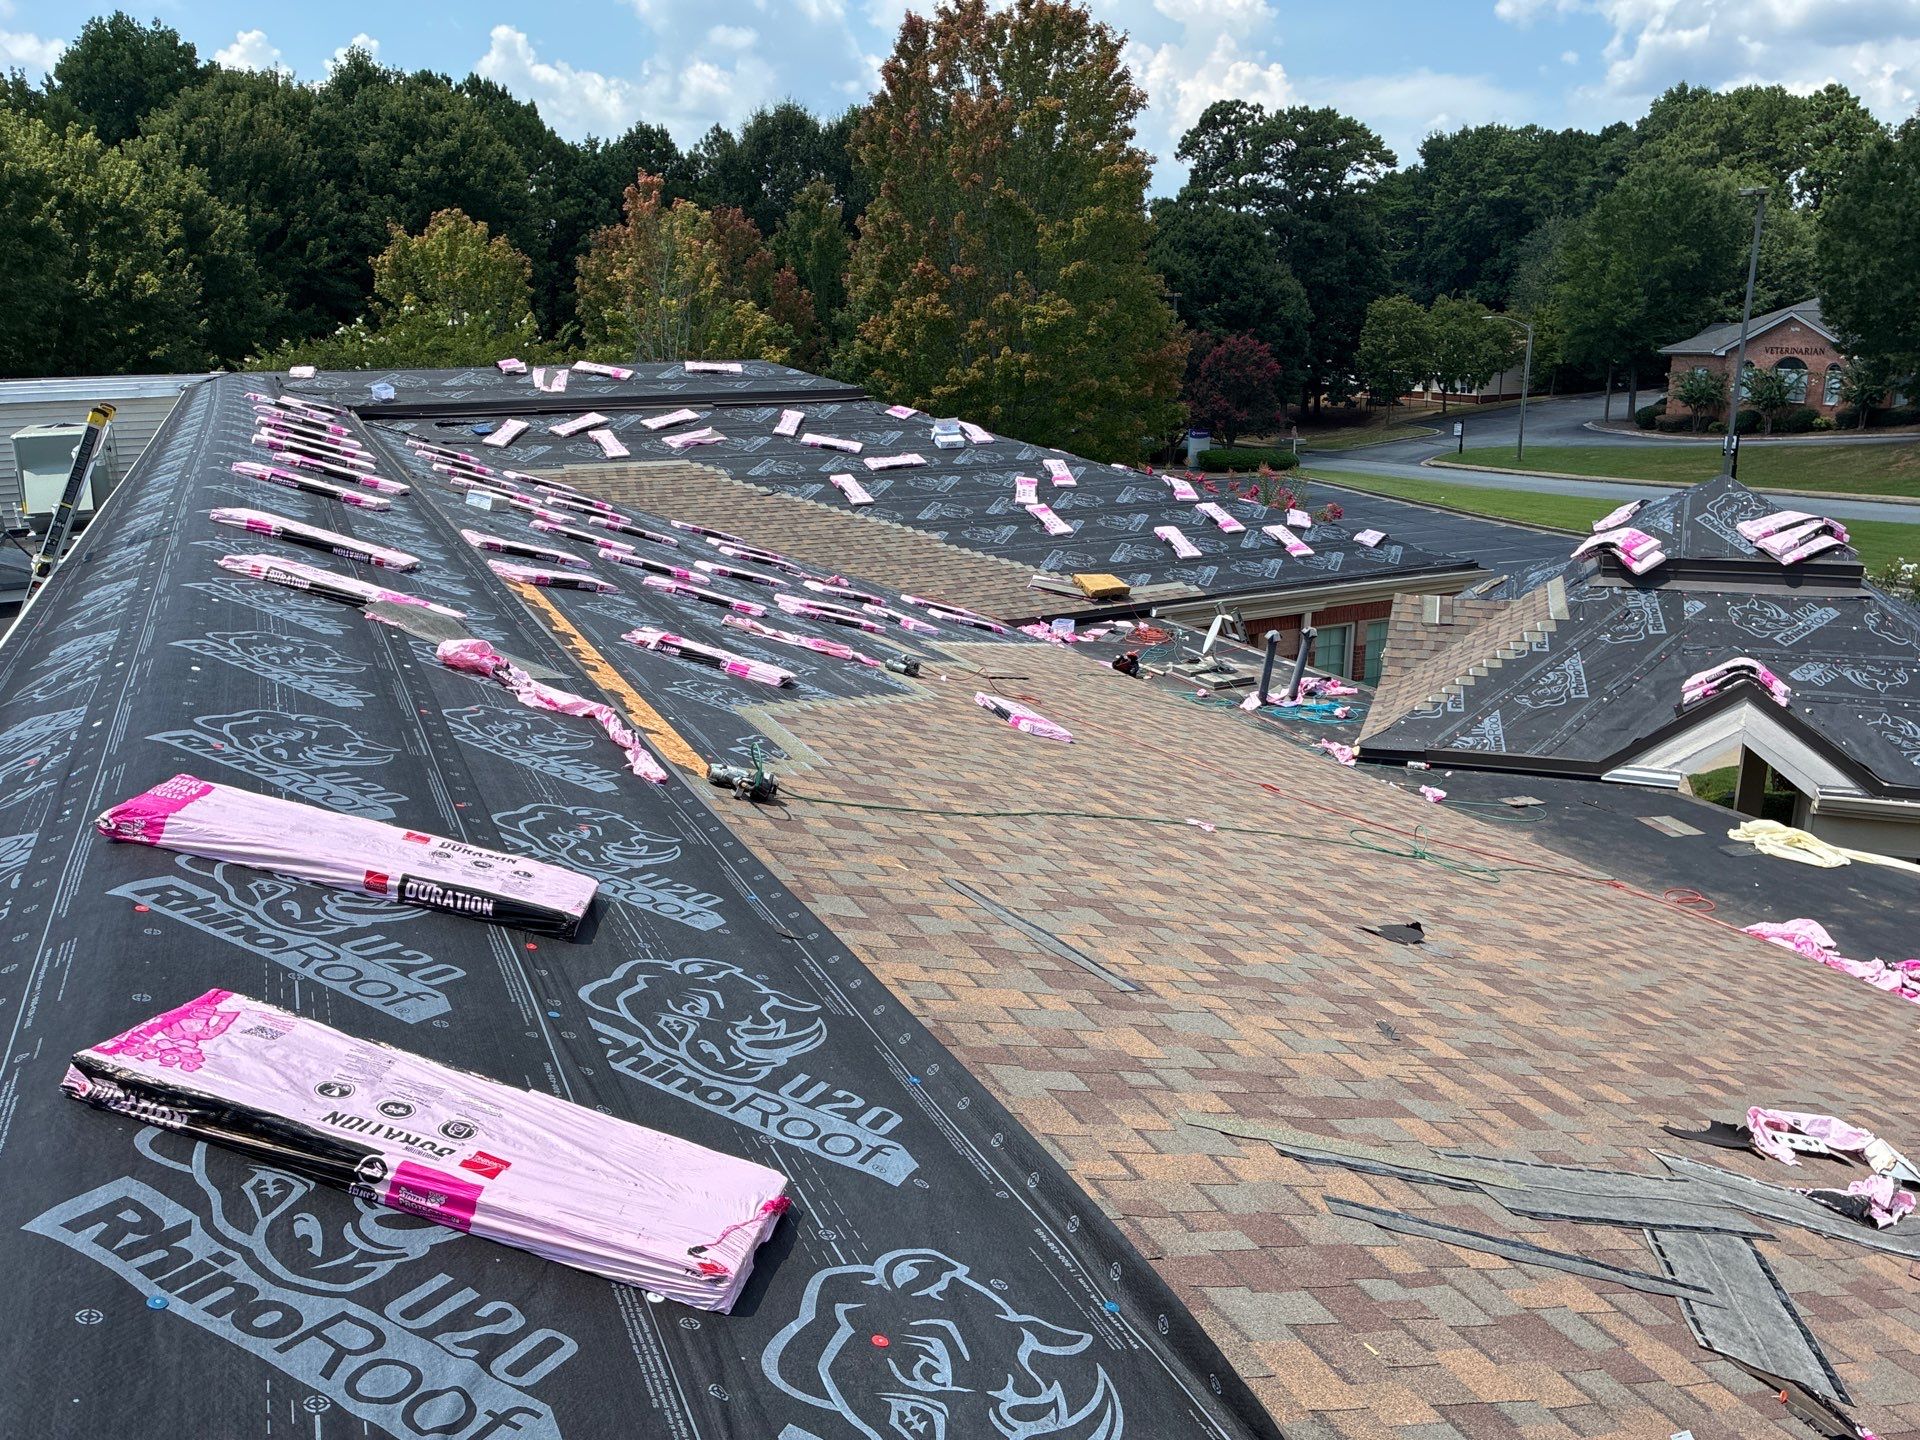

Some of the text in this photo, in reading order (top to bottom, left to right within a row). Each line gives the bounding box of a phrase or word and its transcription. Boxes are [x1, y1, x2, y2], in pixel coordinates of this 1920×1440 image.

[1764, 346, 1827, 356] VETERINARIAN
[1699, 512, 1755, 552] RhinoRoof
[1779, 608, 1834, 646] RhinoRoof
[404, 881, 494, 918] DURATION
[631, 873, 725, 909] U20
[130, 884, 440, 1006] RhinoRoof
[341, 934, 467, 985] U20
[778, 1072, 904, 1136] U20
[1033, 1227, 1076, 1273] 1-800-438-7465
[58, 1194, 543, 1440] RhinoRoof
[384, 1272, 579, 1387] U20
